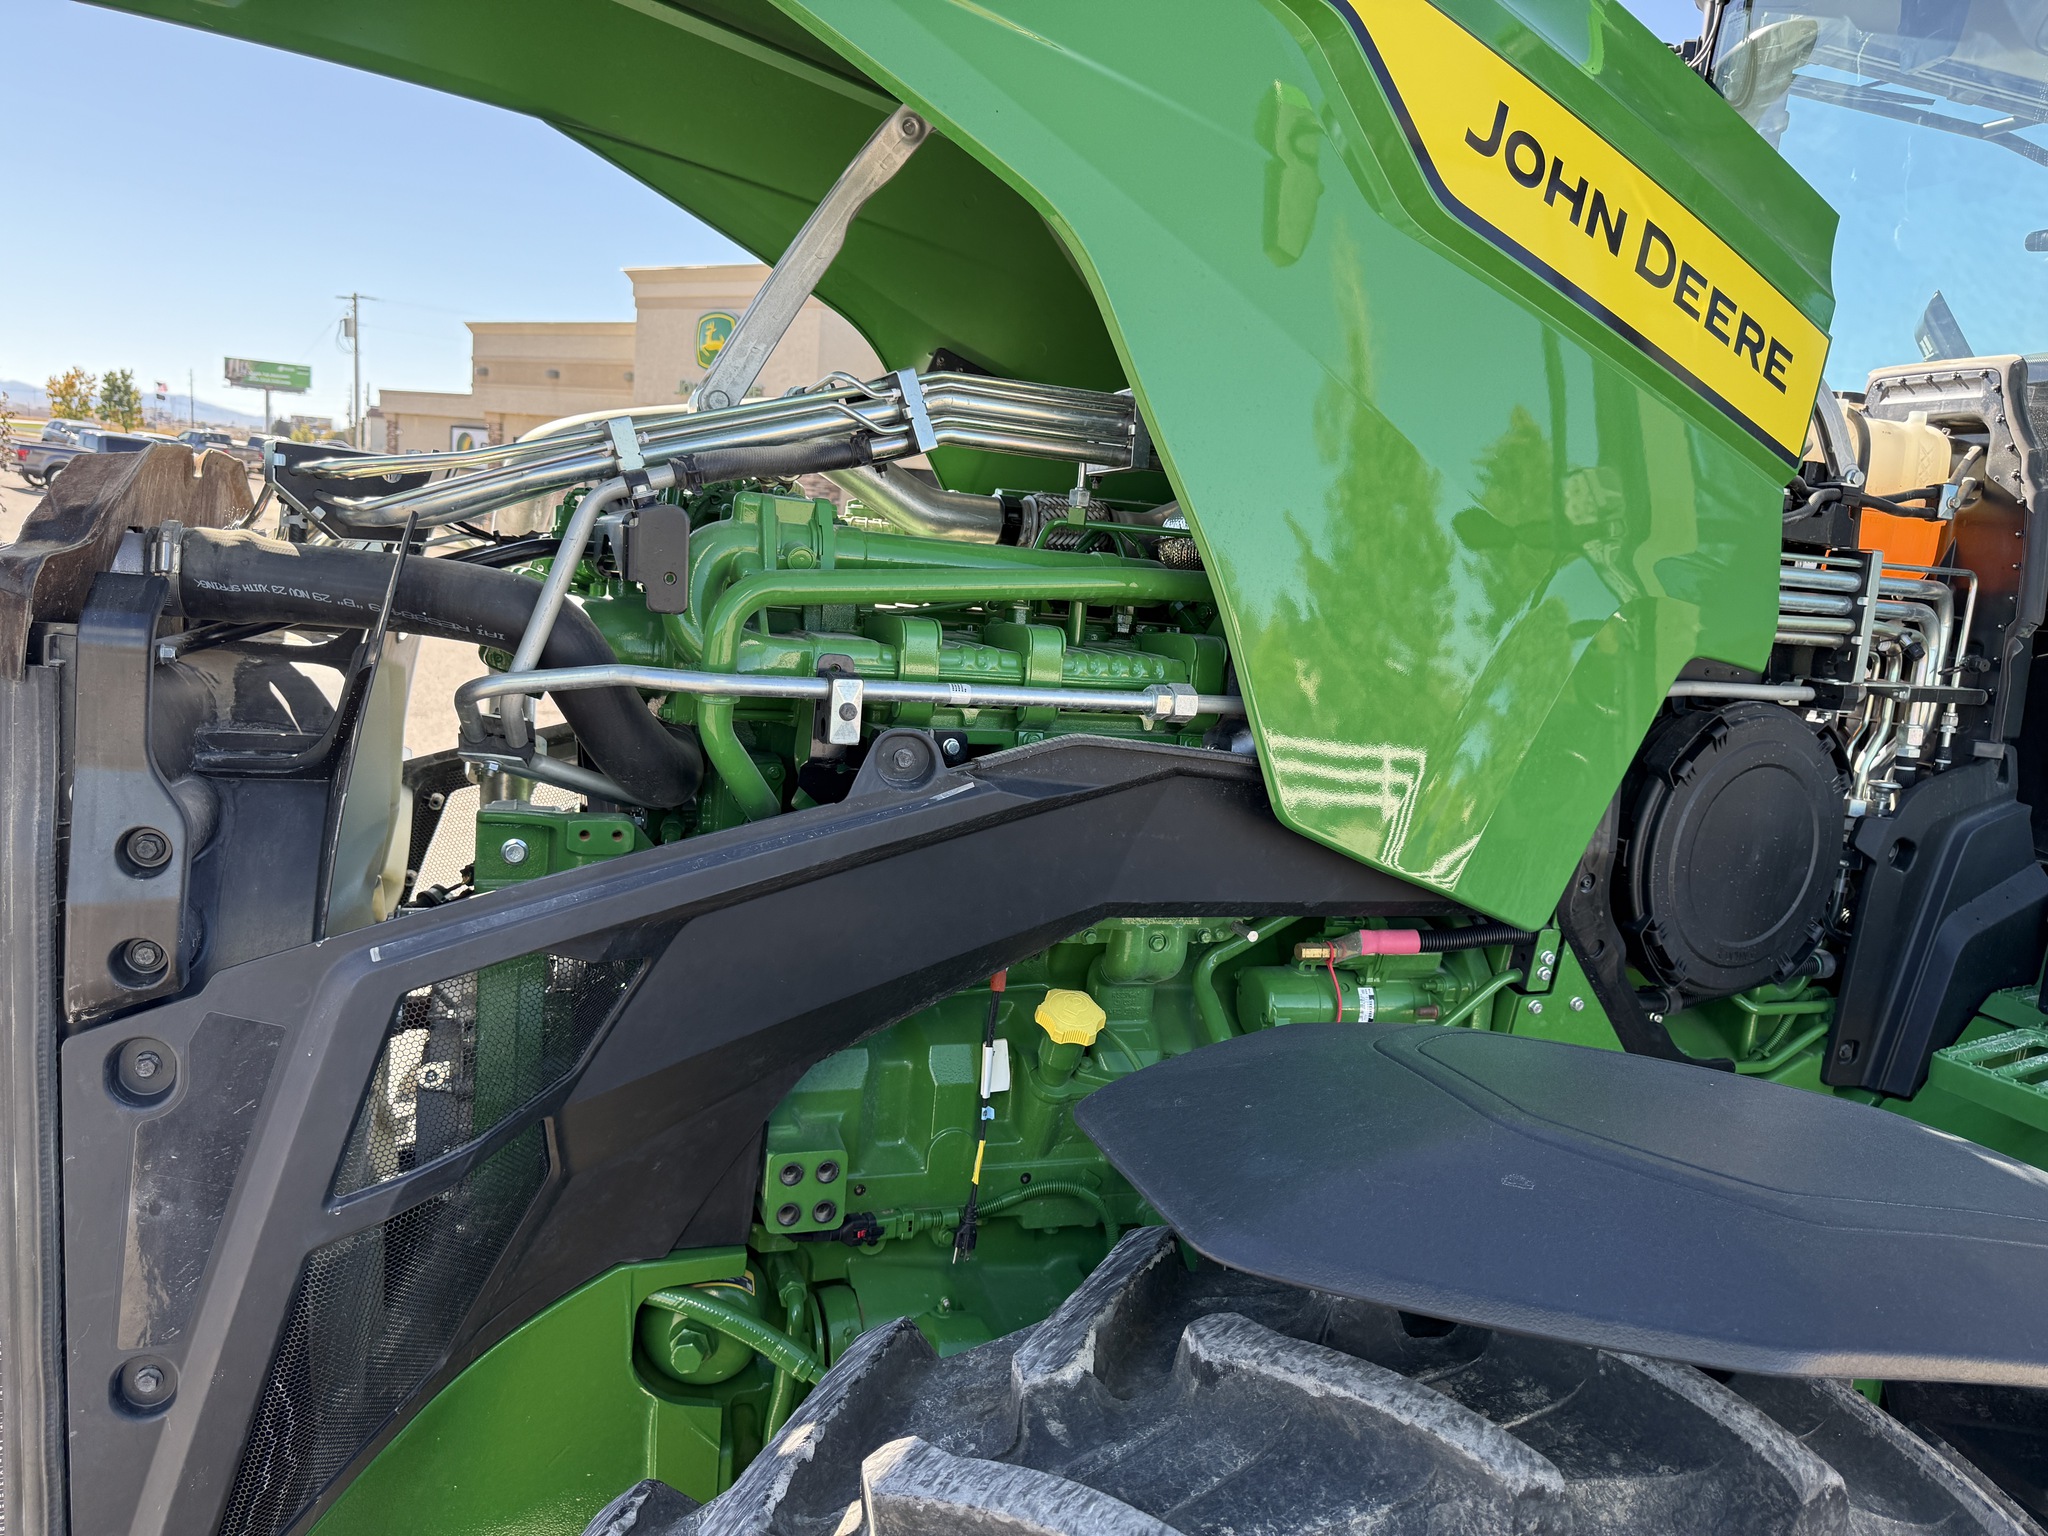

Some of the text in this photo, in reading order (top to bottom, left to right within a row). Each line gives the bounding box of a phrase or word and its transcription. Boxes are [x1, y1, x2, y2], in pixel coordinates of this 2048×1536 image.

[1464, 100, 1794, 395] JOHN DEERE
[271, 585, 287, 595] 23
[288, 587, 310, 600] NOV
[312, 592, 332, 603] 29
